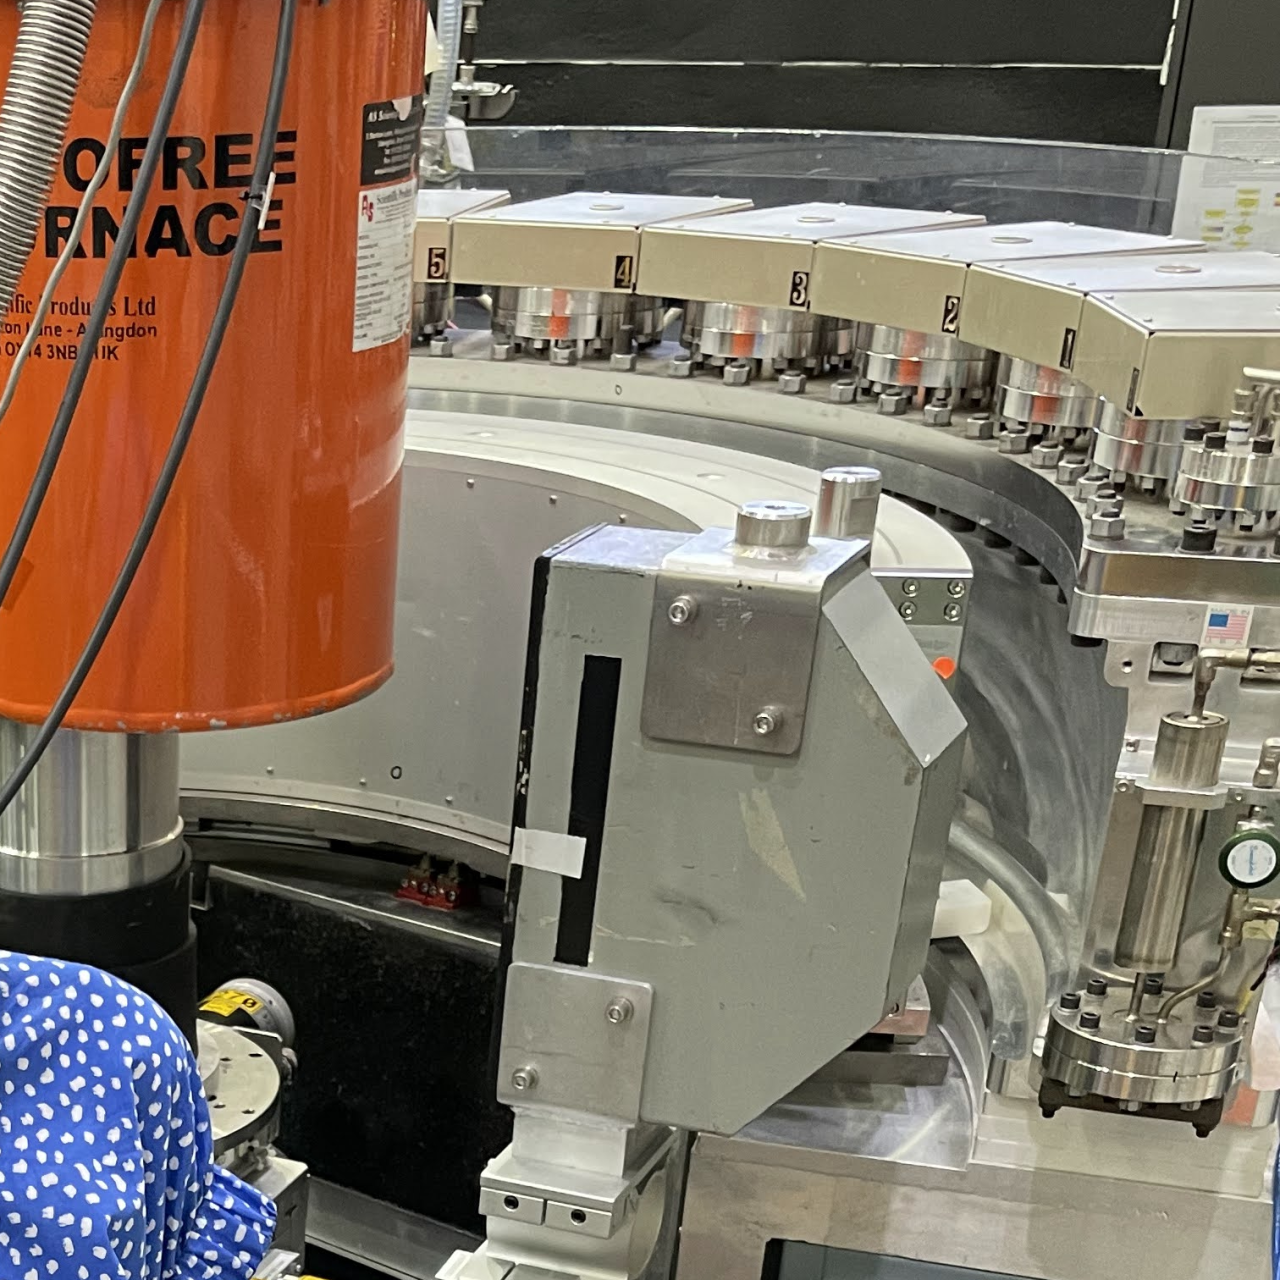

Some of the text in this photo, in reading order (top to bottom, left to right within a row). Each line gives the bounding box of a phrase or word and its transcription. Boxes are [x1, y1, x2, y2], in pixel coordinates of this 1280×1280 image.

[429, 249, 445, 278] 5
[616, 256, 631, 286] 4
[792, 272, 808, 305] 3
[39, 295, 116, 316] rodus
[124, 296, 156, 316] Ltd
[944, 298, 959, 332] 2
[76, 322, 157, 342] Angdon
[1062, 330, 1075, 366] 1
